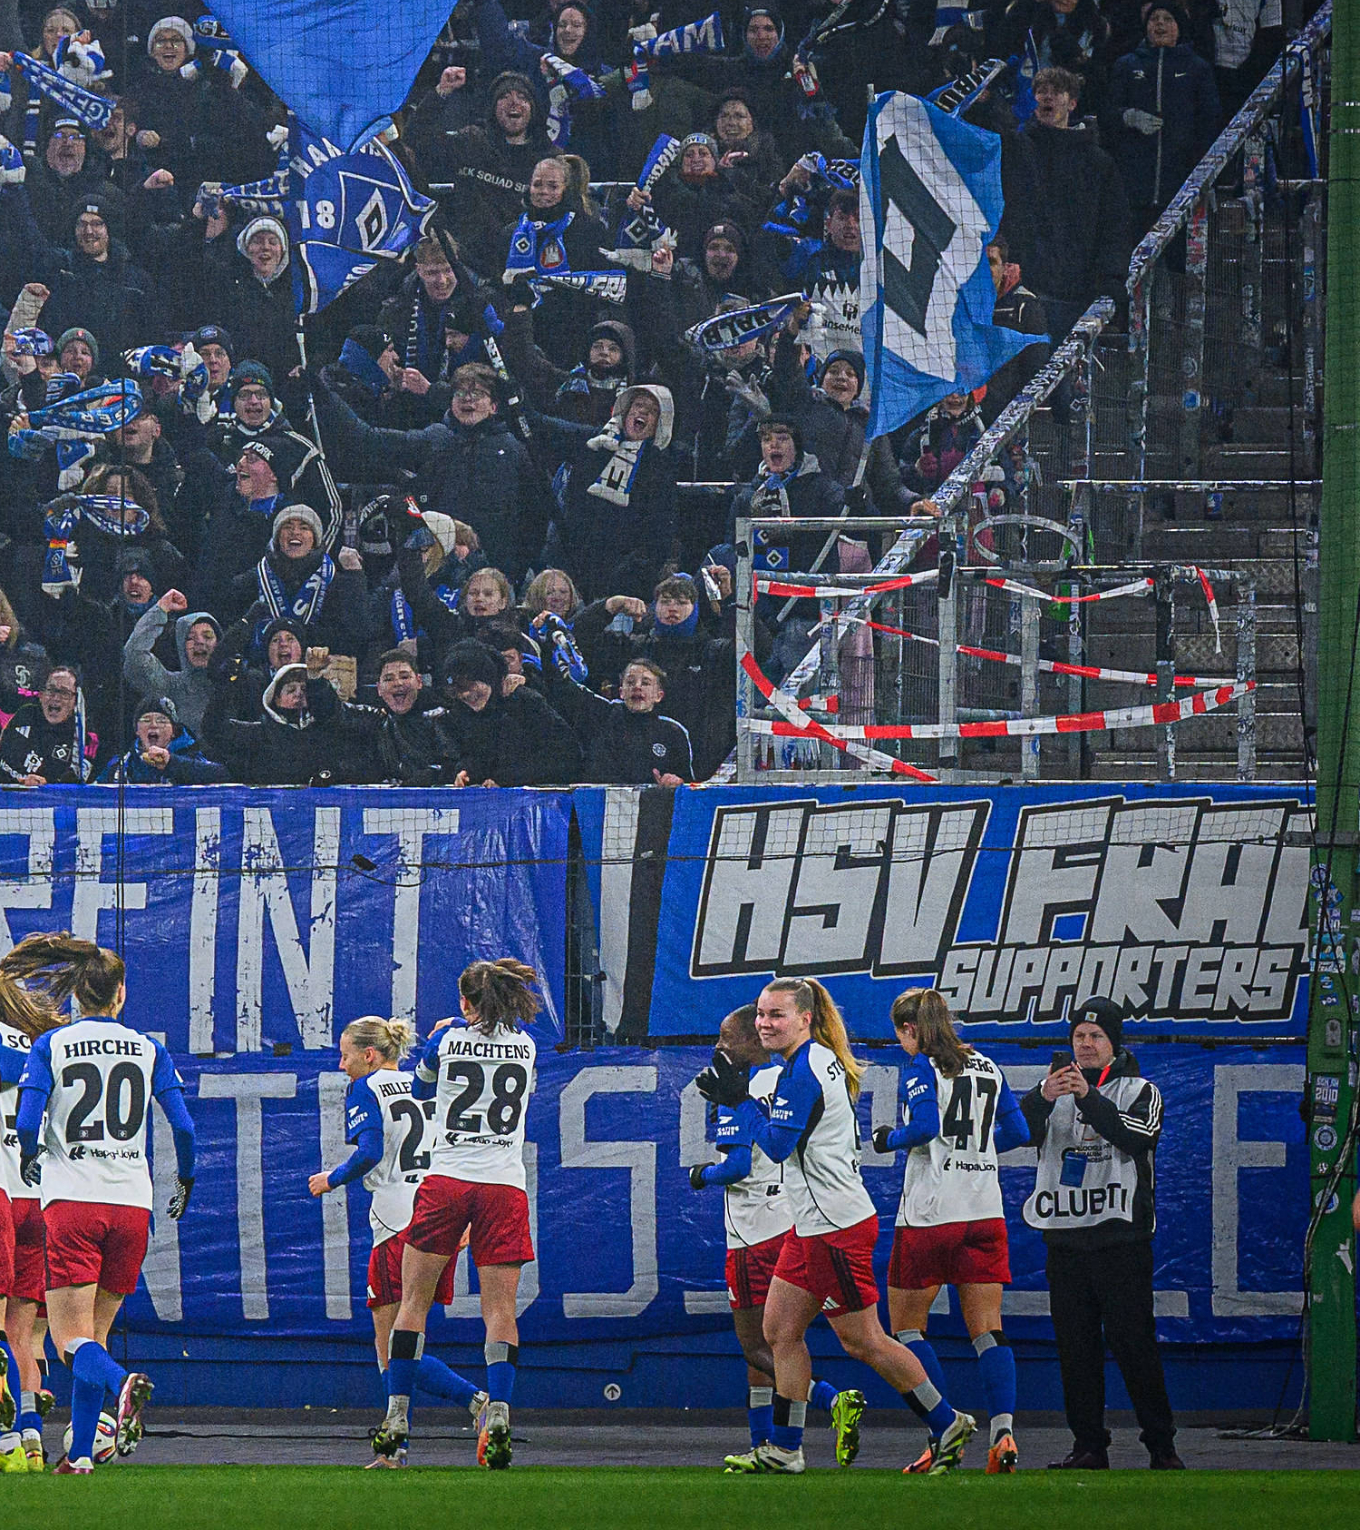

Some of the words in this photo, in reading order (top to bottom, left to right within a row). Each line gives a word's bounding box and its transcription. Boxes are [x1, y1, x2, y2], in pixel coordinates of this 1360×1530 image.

[476, 170, 514, 189] SQUAD
[695, 801, 990, 978] HSV
[940, 943, 1298, 1021] SUPPORTERS
[63, 1040, 143, 1058] HIRCHE
[447, 1041, 530, 1059] MACHTENS
[62, 1061, 145, 1143] 20
[446, 1061, 527, 1135] 28
[943, 1075, 998, 1152] 47
